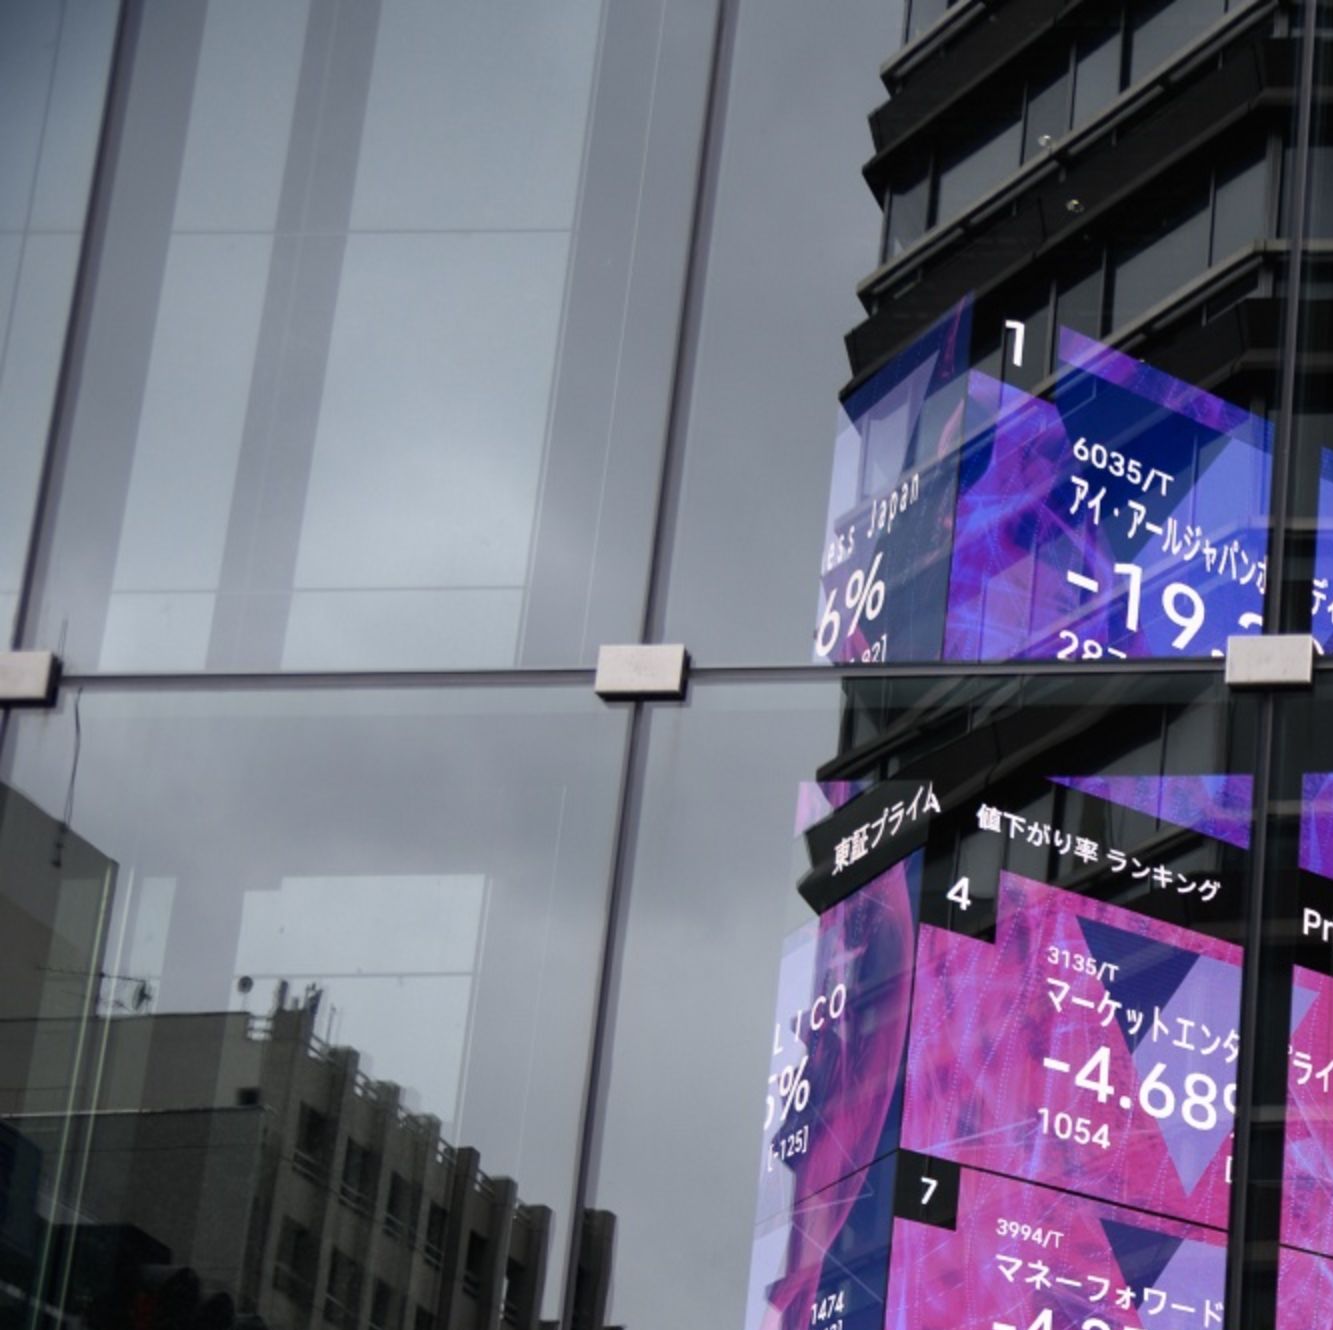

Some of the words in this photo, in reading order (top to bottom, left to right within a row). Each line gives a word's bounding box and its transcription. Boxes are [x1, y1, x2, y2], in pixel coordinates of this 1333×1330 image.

[1005, 319, 1025, 366] 1
[1073, 437, 1174, 497] 6035/T
[867, 472, 919, 539] Japan
[832, 780, 940, 875] 東証プライム
[977, 803, 1098, 863] 値下がり率
[1107, 848, 1221, 902] ランキング
[946, 877, 971, 910] 4
[1047, 945, 1119, 982] 3135/T
[1037, 1107, 1111, 1150] 1054
[920, 1177, 938, 1206] 7
[995, 1218, 1065, 1250] 3994/T
[810, 1290, 844, 1326] 1474
[995, 1253, 1224, 1329] マネーフォワード
